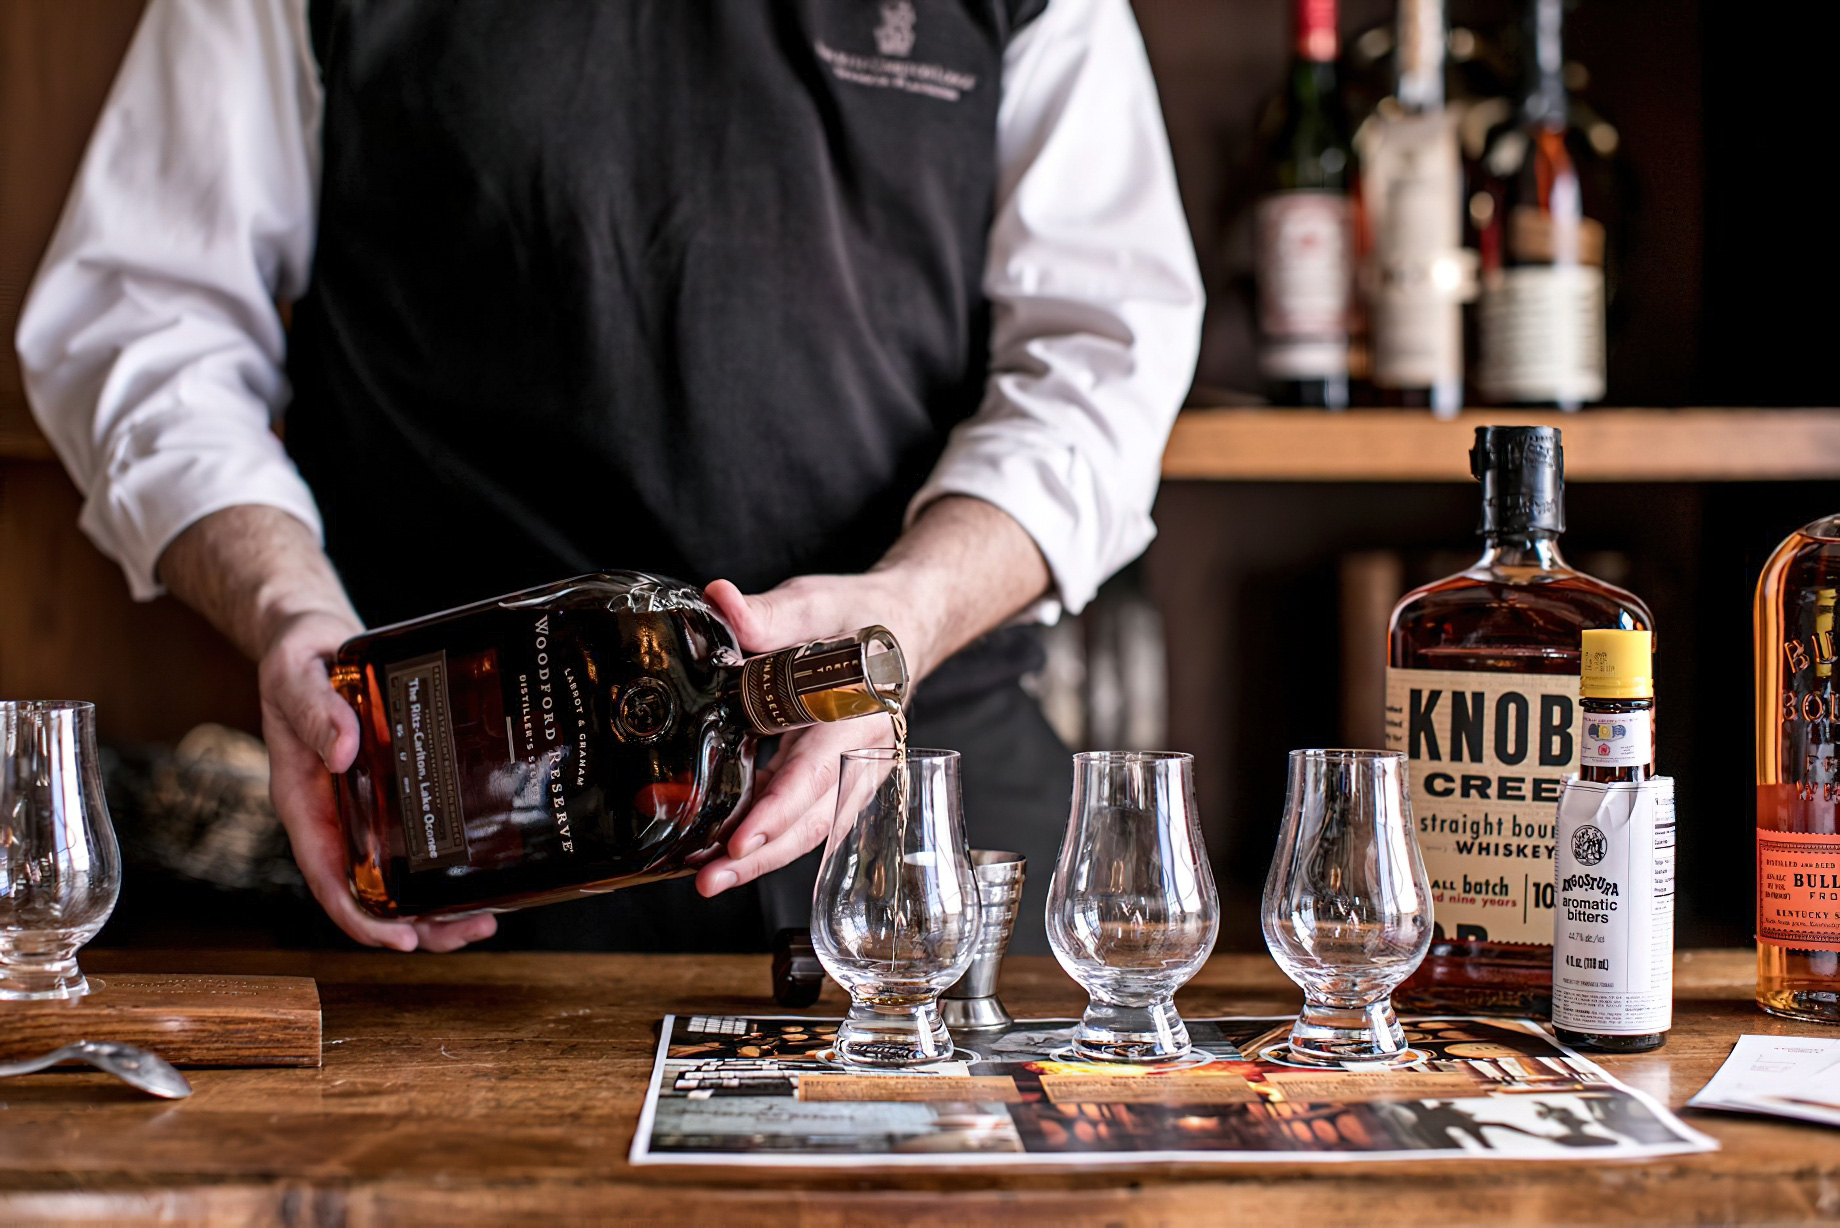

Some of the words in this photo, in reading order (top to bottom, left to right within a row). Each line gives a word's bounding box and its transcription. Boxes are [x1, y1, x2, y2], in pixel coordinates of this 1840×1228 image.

[763, 653, 776, 690] ONAL
[408, 677, 420, 703] The
[564, 668, 583, 714] LABROT
[519, 675, 535, 750] DISTILLER'S
[577, 719, 586, 728] &
[535, 614, 556, 741] WOODFORD
[548, 751, 574, 852] RESERVE
[1409, 688, 1573, 766] KNOB
[410, 704, 429, 780] Ritz-Carlton,
[576, 732, 587, 786] GRAHAM
[420, 782, 433, 812] Lake
[423, 813, 439, 859] Oconee
[1420, 812, 1503, 840] straight
[1455, 840, 1556, 859] WHISKEY
[1462, 874, 1509, 897] batch
[1793, 873, 1840, 889] BULL
[1449, 893, 1476, 905] nine
[1481, 897, 1517, 908] years
[1562, 897, 1618, 911] aromatic
[1776, 909, 1829, 919] KENTUCKY
[1567, 908, 1609, 923] bitters
